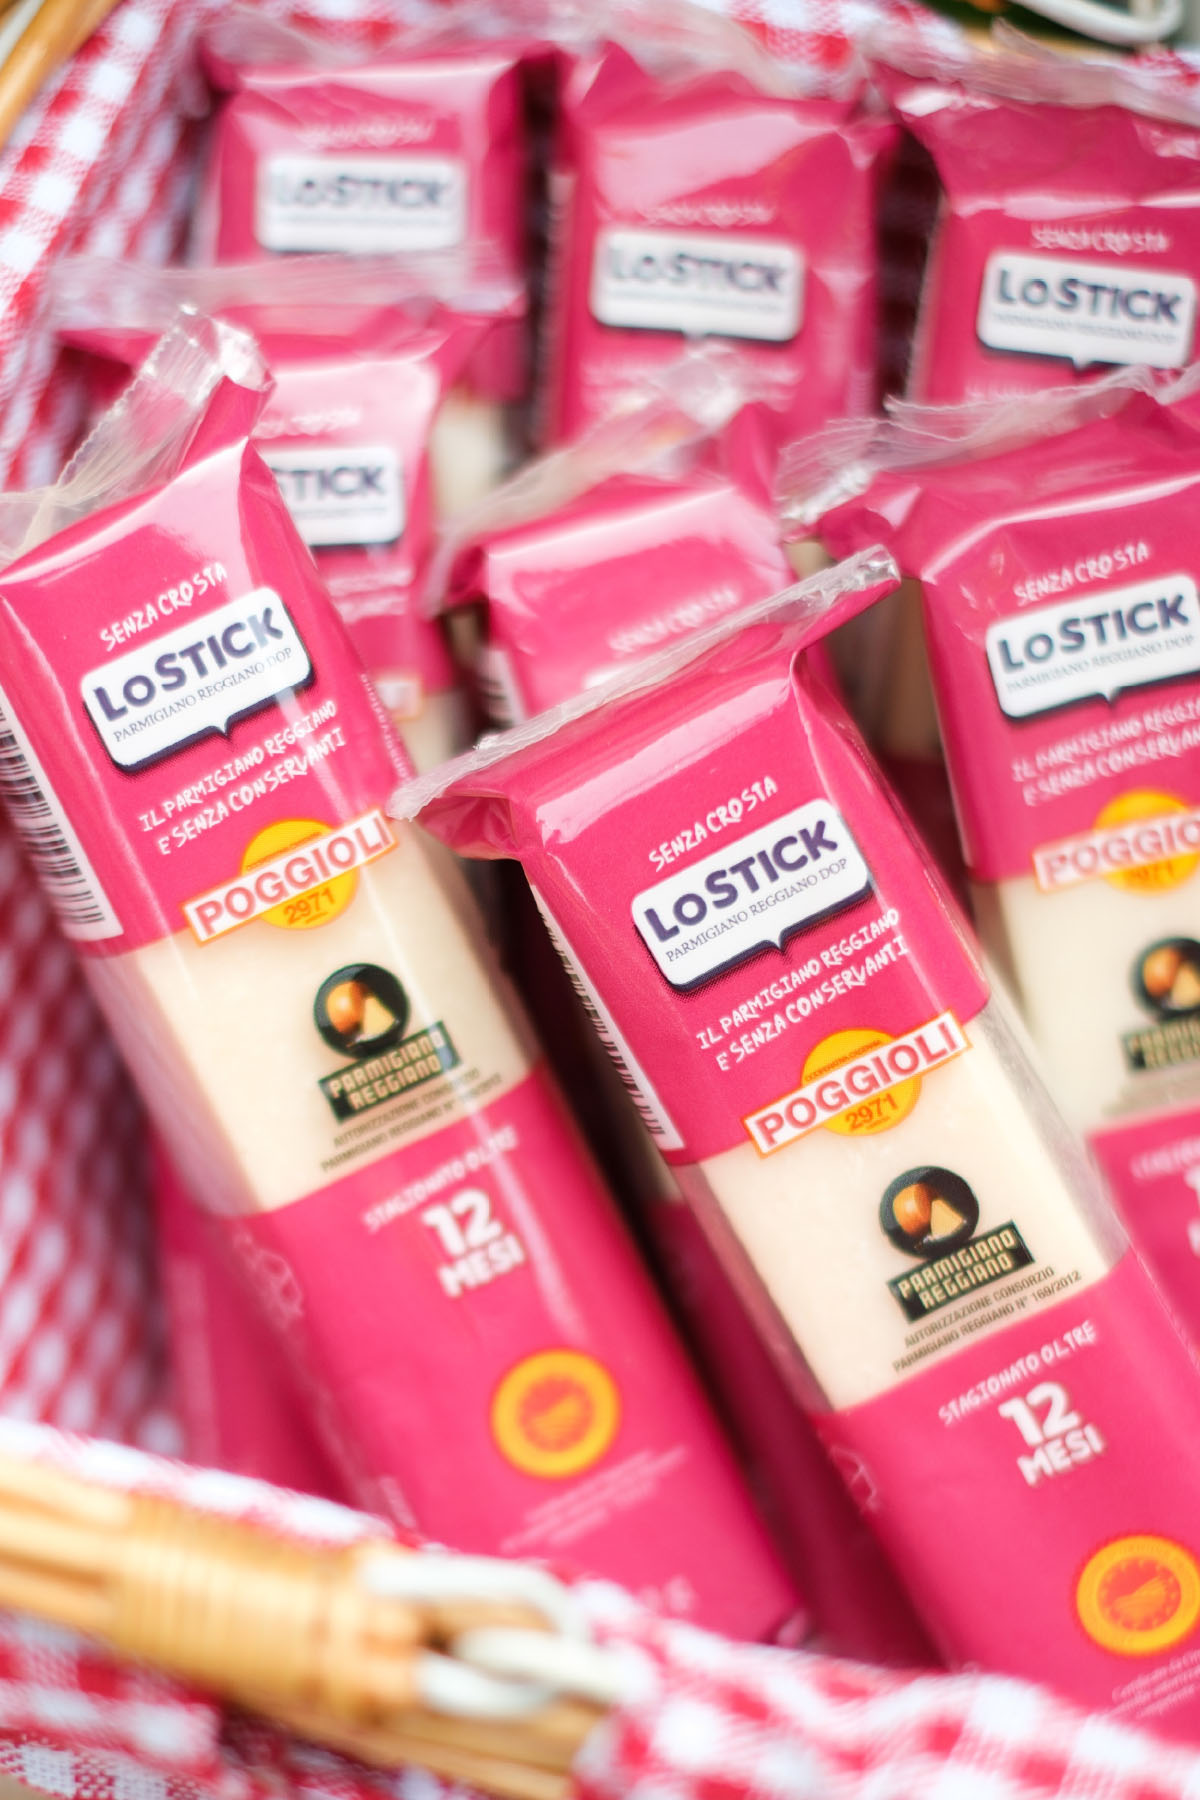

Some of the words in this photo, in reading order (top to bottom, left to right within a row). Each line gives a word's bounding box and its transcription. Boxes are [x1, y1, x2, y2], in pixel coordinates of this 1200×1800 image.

[99, 606, 160, 652] SENZA
[157, 561, 228, 618] CROSTA
[113, 693, 196, 743] PARMIGIANO
[196, 662, 266, 701] REGGIANO
[265, 646, 293, 672] DOP
[139, 810, 164, 832] IL
[162, 747, 265, 817] PARMIGIANO
[264, 700, 337, 757] REGGIANO
[173, 802, 231, 850] SENZA
[229, 726, 346, 812] CONSERVANTI
[649, 819, 707, 872] SENZA
[706, 776, 778, 833] CROSTA
[193, 814, 392, 938] POGGIOLI
[283, 887, 335, 925] 2971
[665, 910, 749, 962] PARMIGIANO
[749, 878, 818, 919] REGGIANO
[819, 857, 848, 882] DOP
[696, 1028, 721, 1050] IL
[719, 960, 821, 1033] PARMIGIANO
[820, 908, 900, 970] REGGIANO
[729, 1017, 787, 1065] SENZA
[785, 935, 909, 1023] CONSERVANTI
[330, 1026, 446, 1099] PARMIGIANO
[350, 1056, 442, 1111] REGGIANO
[754, 1021, 959, 1148] POGGIOLI
[845, 1092, 898, 1133] 2971
[422, 1188, 502, 1258] 12
[439, 1233, 526, 1297] MESI
[897, 1227, 1017, 1299] PARMIGIANO
[892, 1331, 961, 1373] PARMIGIANO
[960, 1304, 1015, 1336] REGGIANO
[1033, 1269, 1082, 1304] 169/2012
[904, 1294, 993, 1349] AUTORIZZAZIONE
[991, 1266, 1055, 1303] CONSORZIO
[917, 1253, 1013, 1310] REGGIANO
[938, 1353, 1040, 1428] STAGIONATO
[1040, 1319, 1097, 1366] OLTRE
[998, 1381, 1080, 1447] 12
[1016, 1424, 1105, 1488] MESI
